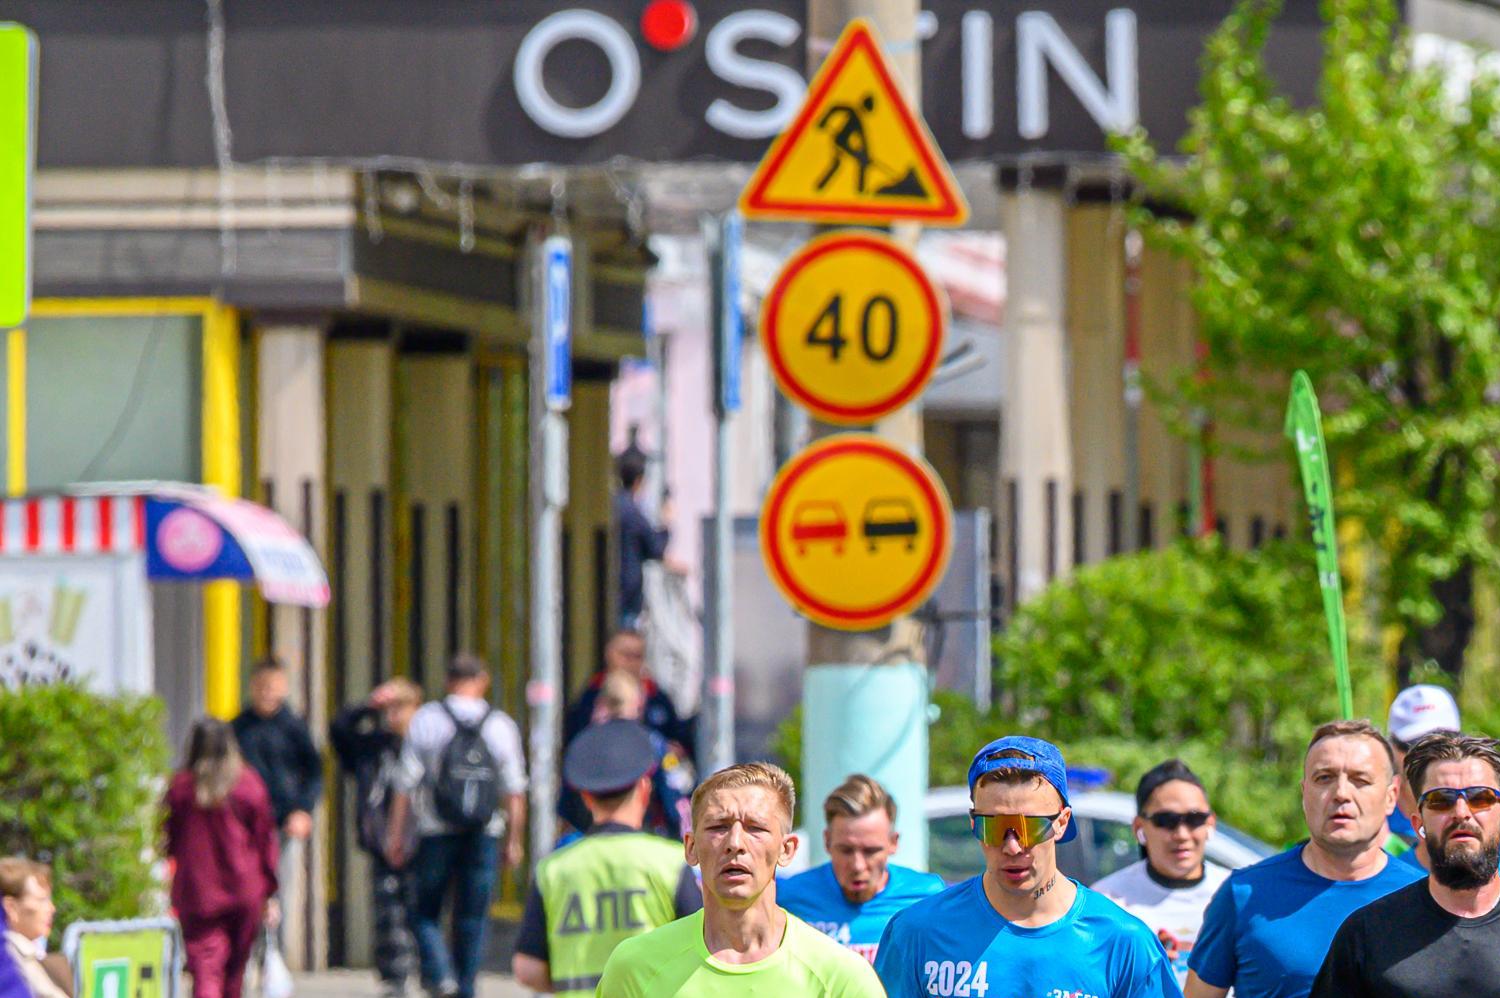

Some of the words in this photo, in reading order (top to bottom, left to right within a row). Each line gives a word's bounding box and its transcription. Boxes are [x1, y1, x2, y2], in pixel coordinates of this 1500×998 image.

[806, 294, 898, 361] 40
[557, 889, 646, 935] ДПС
[924, 960, 989, 998] 2024
